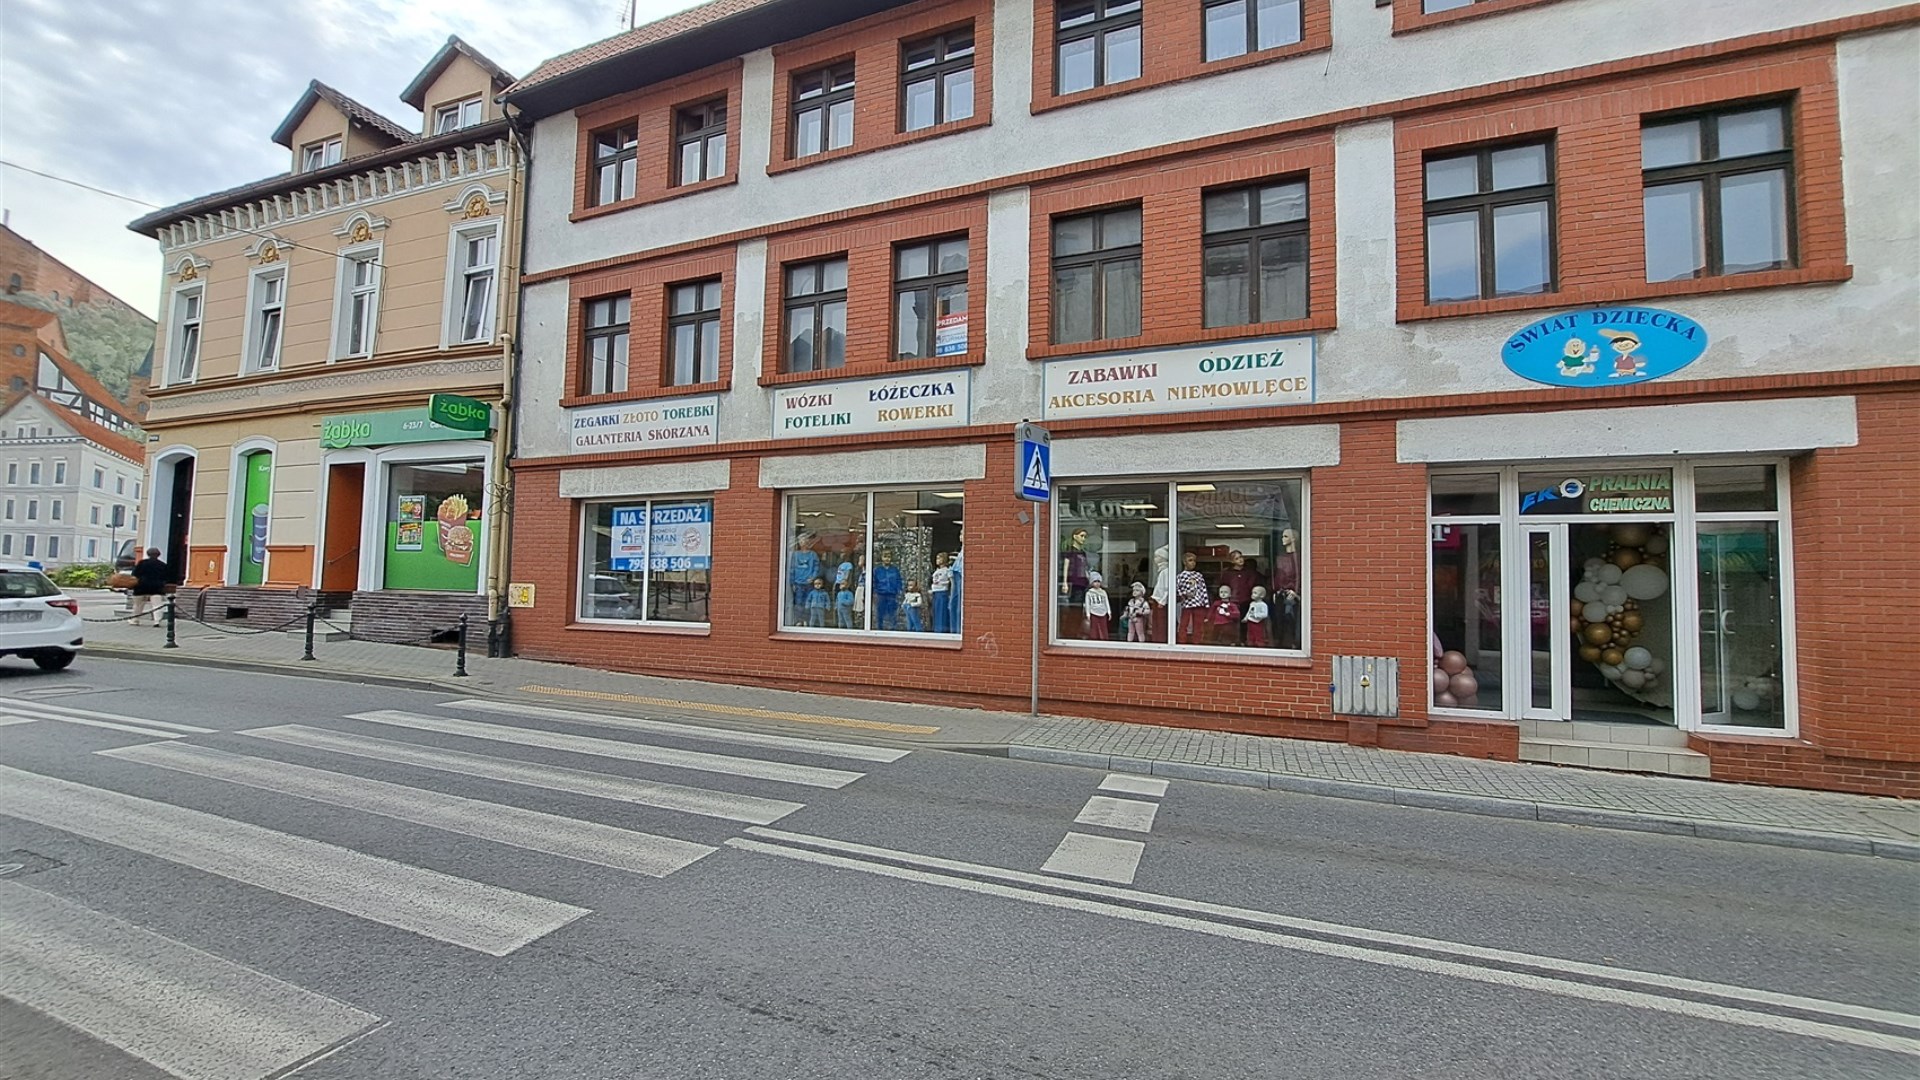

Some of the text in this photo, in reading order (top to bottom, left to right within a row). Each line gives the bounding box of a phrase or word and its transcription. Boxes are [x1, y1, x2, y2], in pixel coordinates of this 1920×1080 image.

[1592, 311, 1697, 341] DZIECKA
[1199, 349, 1284, 373] ODZIEŻ
[1067, 363, 1158, 385] ZABAWKI
[785, 393, 833, 409] WÓZKI
[868, 382, 955, 402] ŁÓŻECZKA
[1048, 376, 1308, 409] AKCESORIA NIEMOWLĘCE
[440, 399, 486, 420] żabka
[574, 404, 715, 429] ZEGARKI ZŁOTO TOREBKI
[877, 403, 954, 422] ROWERKI
[784, 412, 851, 429] FOTELIKI
[323, 419, 372, 442] żabka
[575, 431, 642, 447] GALANTERIA
[1588, 473, 1671, 492] PRALNIA
[1589, 496, 1671, 512] CHEMICZNA
[620, 511, 637, 525] NA
[670, 557, 692, 569] 506
